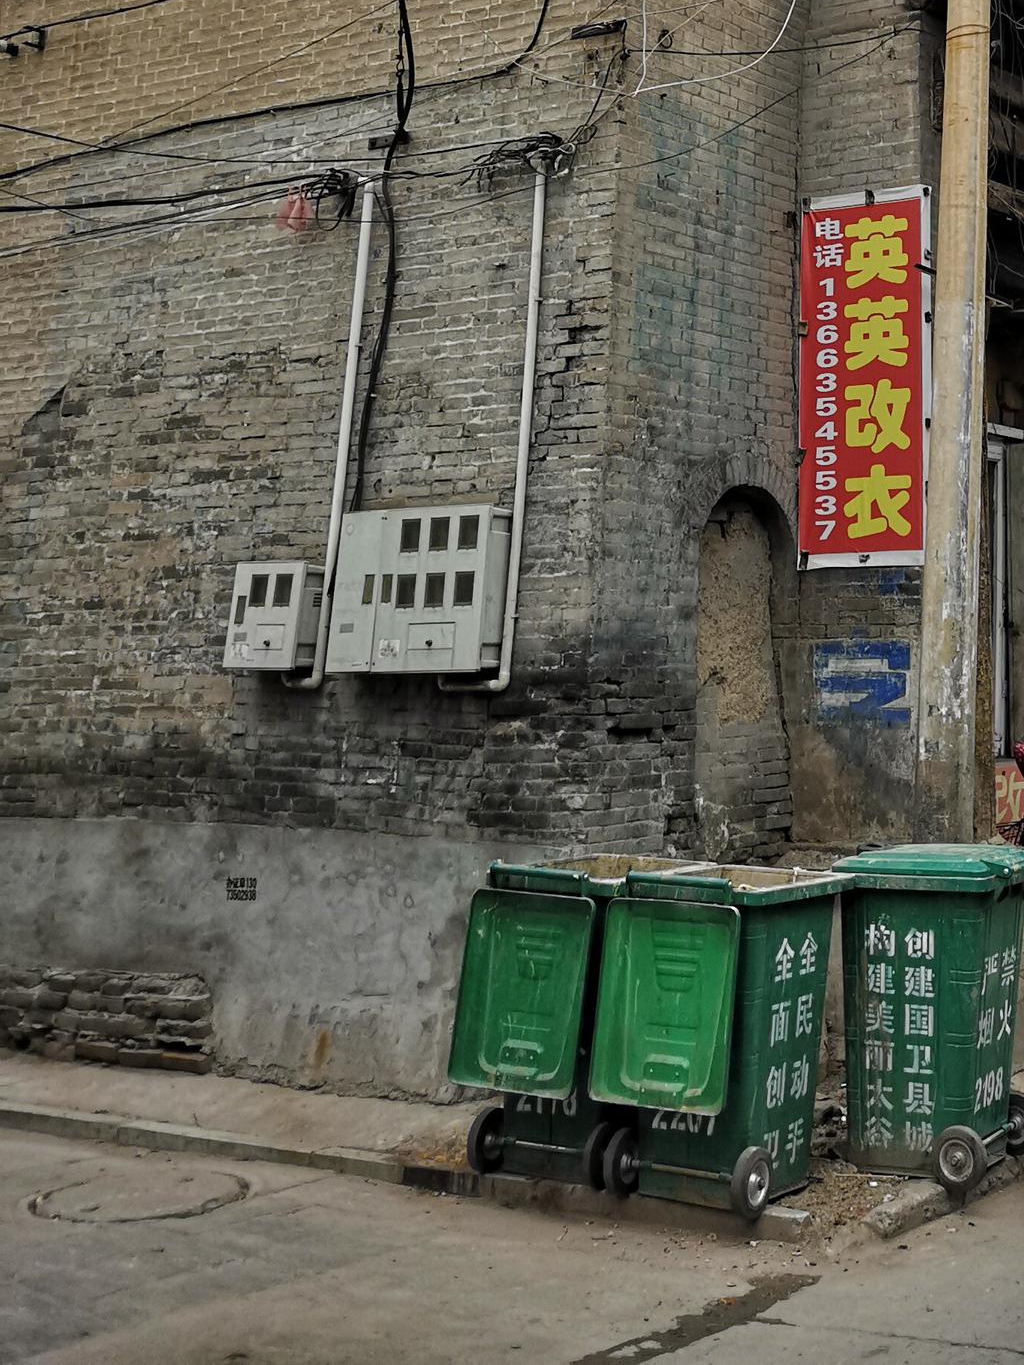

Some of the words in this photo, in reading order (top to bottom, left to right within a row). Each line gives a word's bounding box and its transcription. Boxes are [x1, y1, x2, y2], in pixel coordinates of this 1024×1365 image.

[813, 217, 844, 269] 电话
[843, 213, 912, 539] 英英改衣
[814, 277, 840, 541] 13663545537
[981, 945, 1017, 996] 严禁
[785, 931, 818, 1165] 全民动手
[976, 999, 1013, 1050] 烟火
[973, 1066, 1004, 1115] 2198
